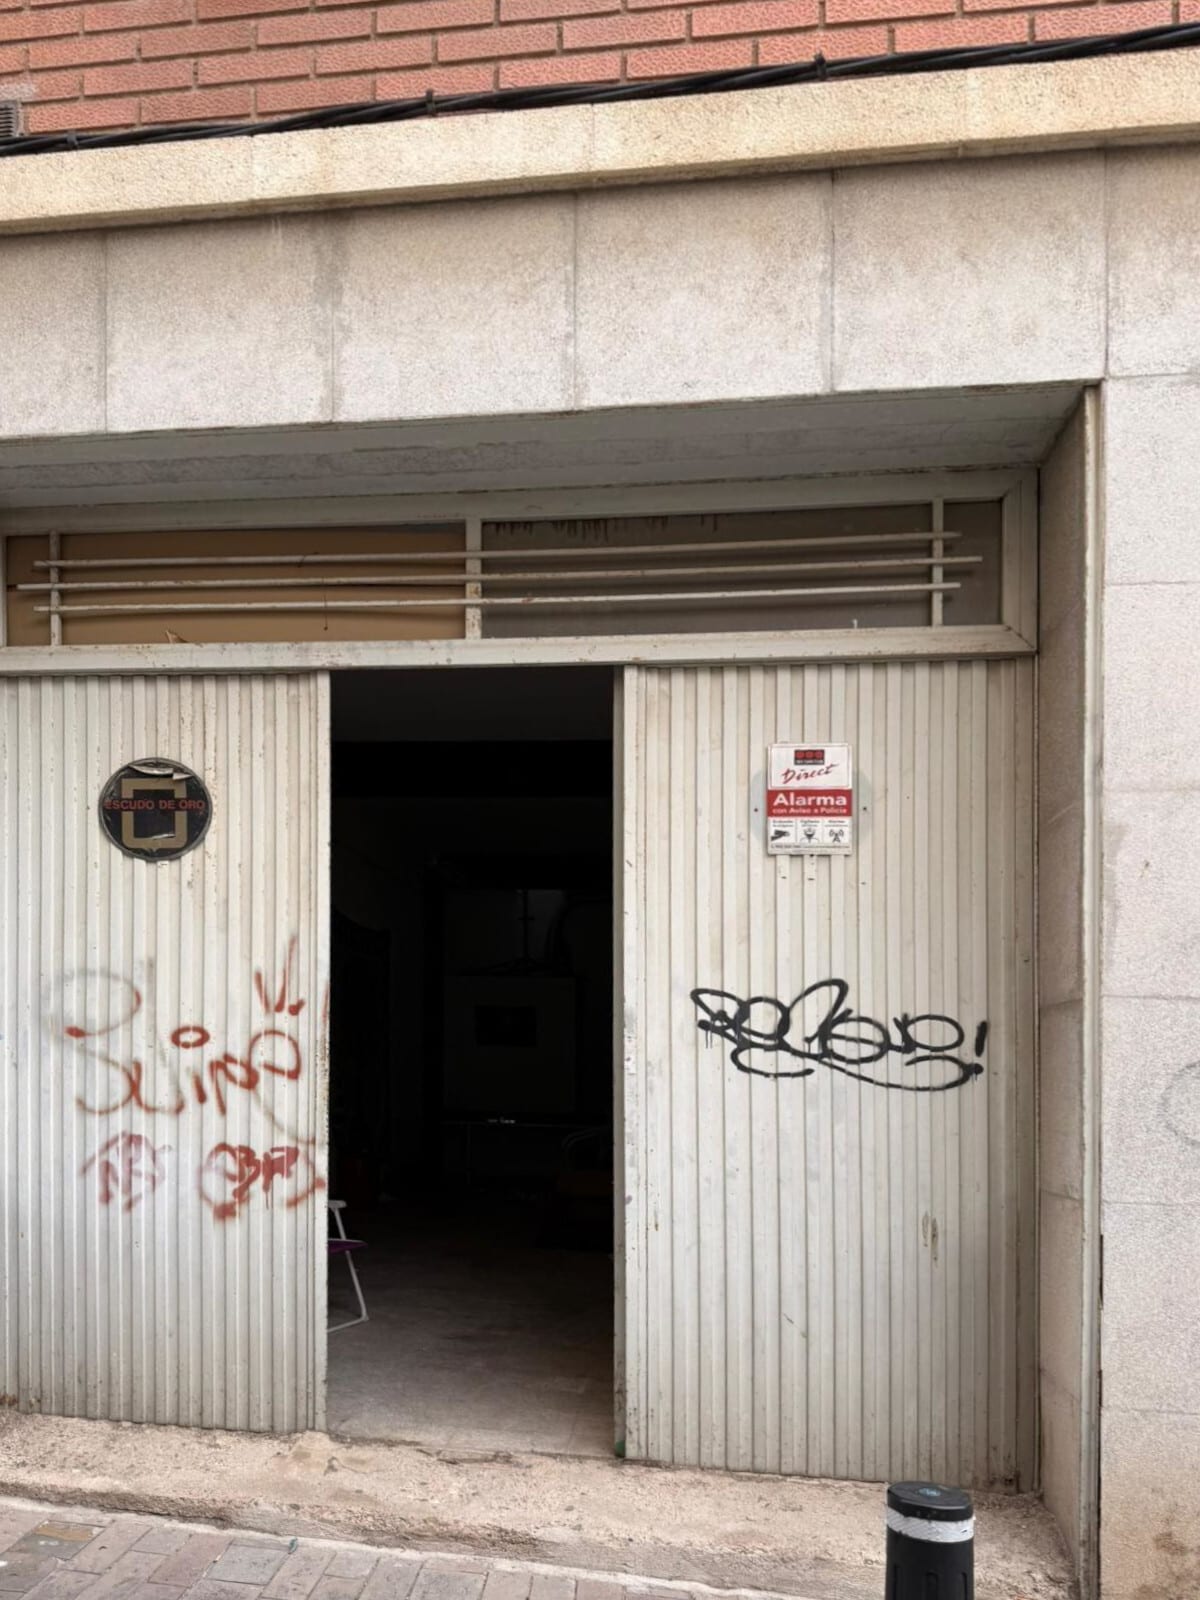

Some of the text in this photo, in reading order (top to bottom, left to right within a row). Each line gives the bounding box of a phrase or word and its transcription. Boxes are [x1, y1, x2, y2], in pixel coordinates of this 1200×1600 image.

[781, 763, 840, 784] Direct
[104, 799, 206, 810] ESCUDO DE ORO
[773, 792, 847, 806] Alarma
